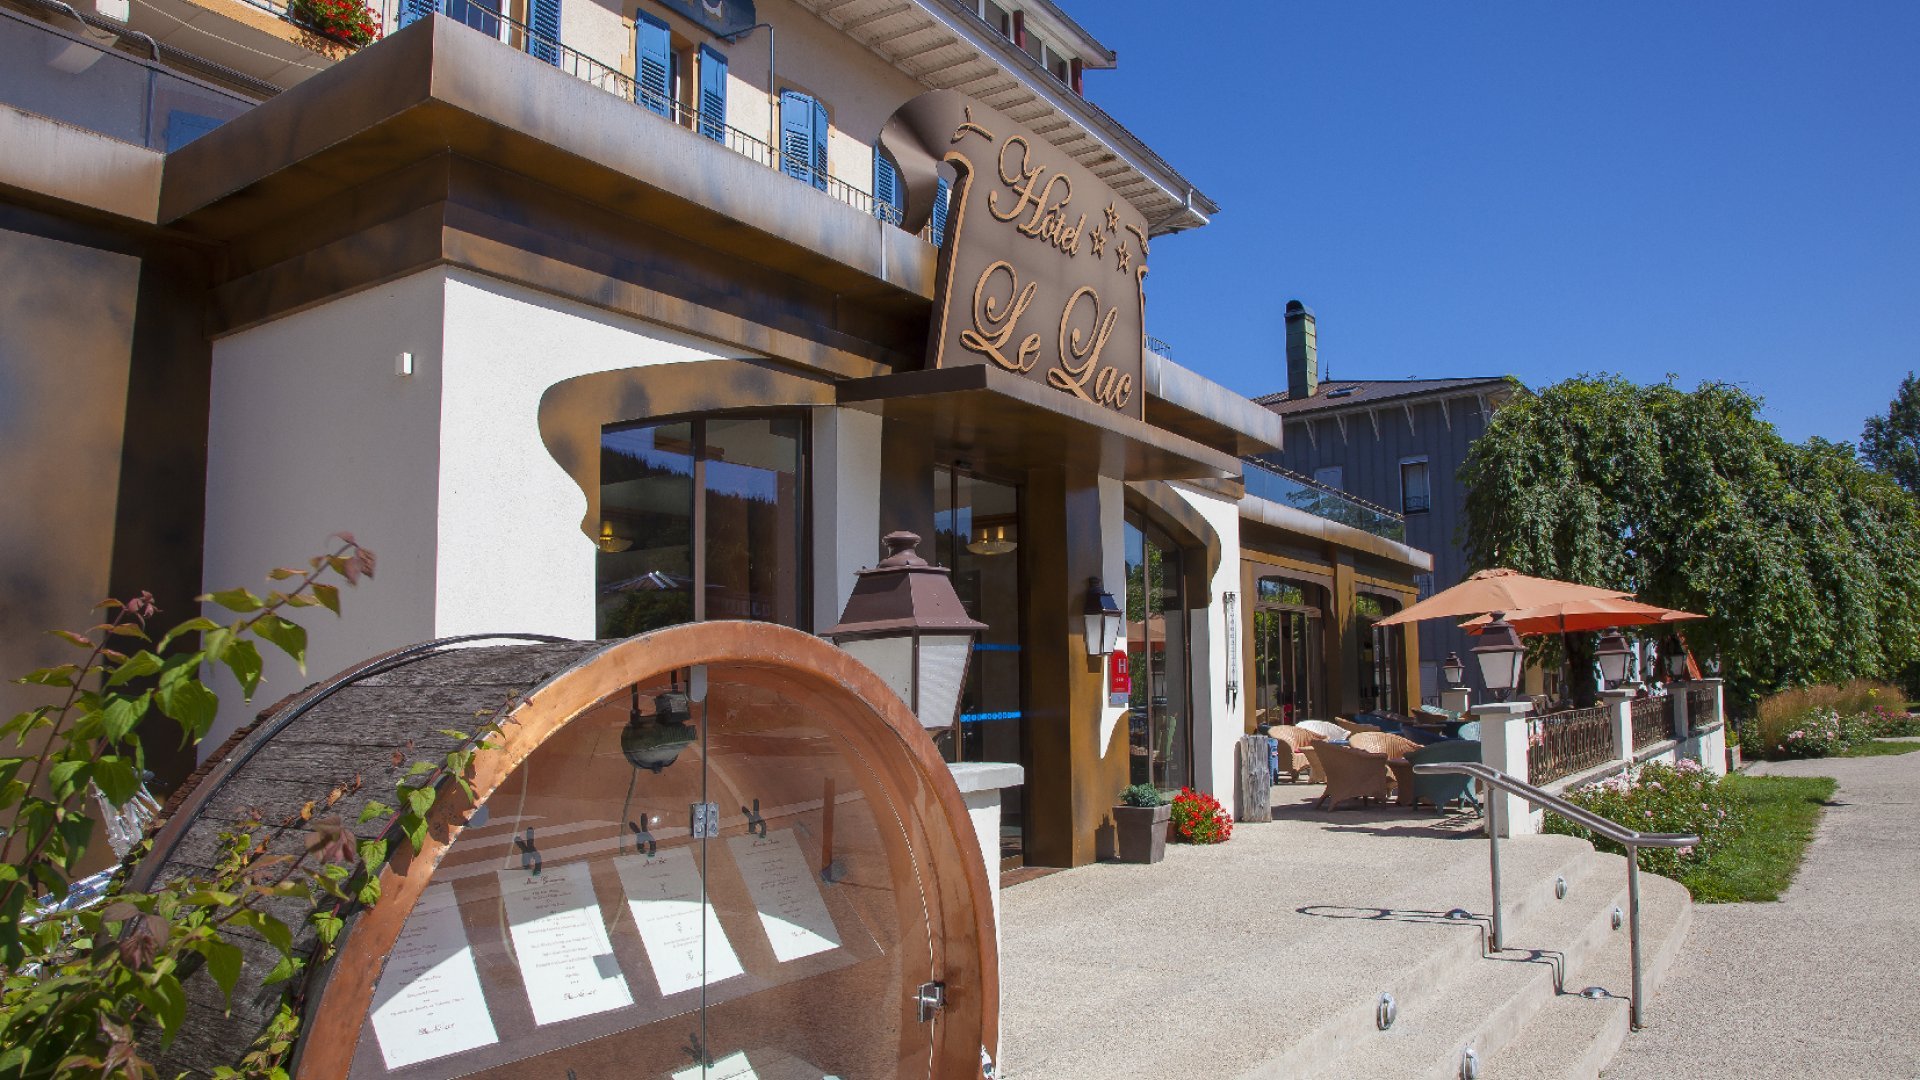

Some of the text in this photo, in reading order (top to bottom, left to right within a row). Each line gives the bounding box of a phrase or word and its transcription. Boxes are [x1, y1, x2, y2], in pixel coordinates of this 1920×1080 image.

[988, 135, 1087, 256] Hôtel
[959, 260, 1132, 408] Le Lac
[1118, 658, 1127, 674] H
